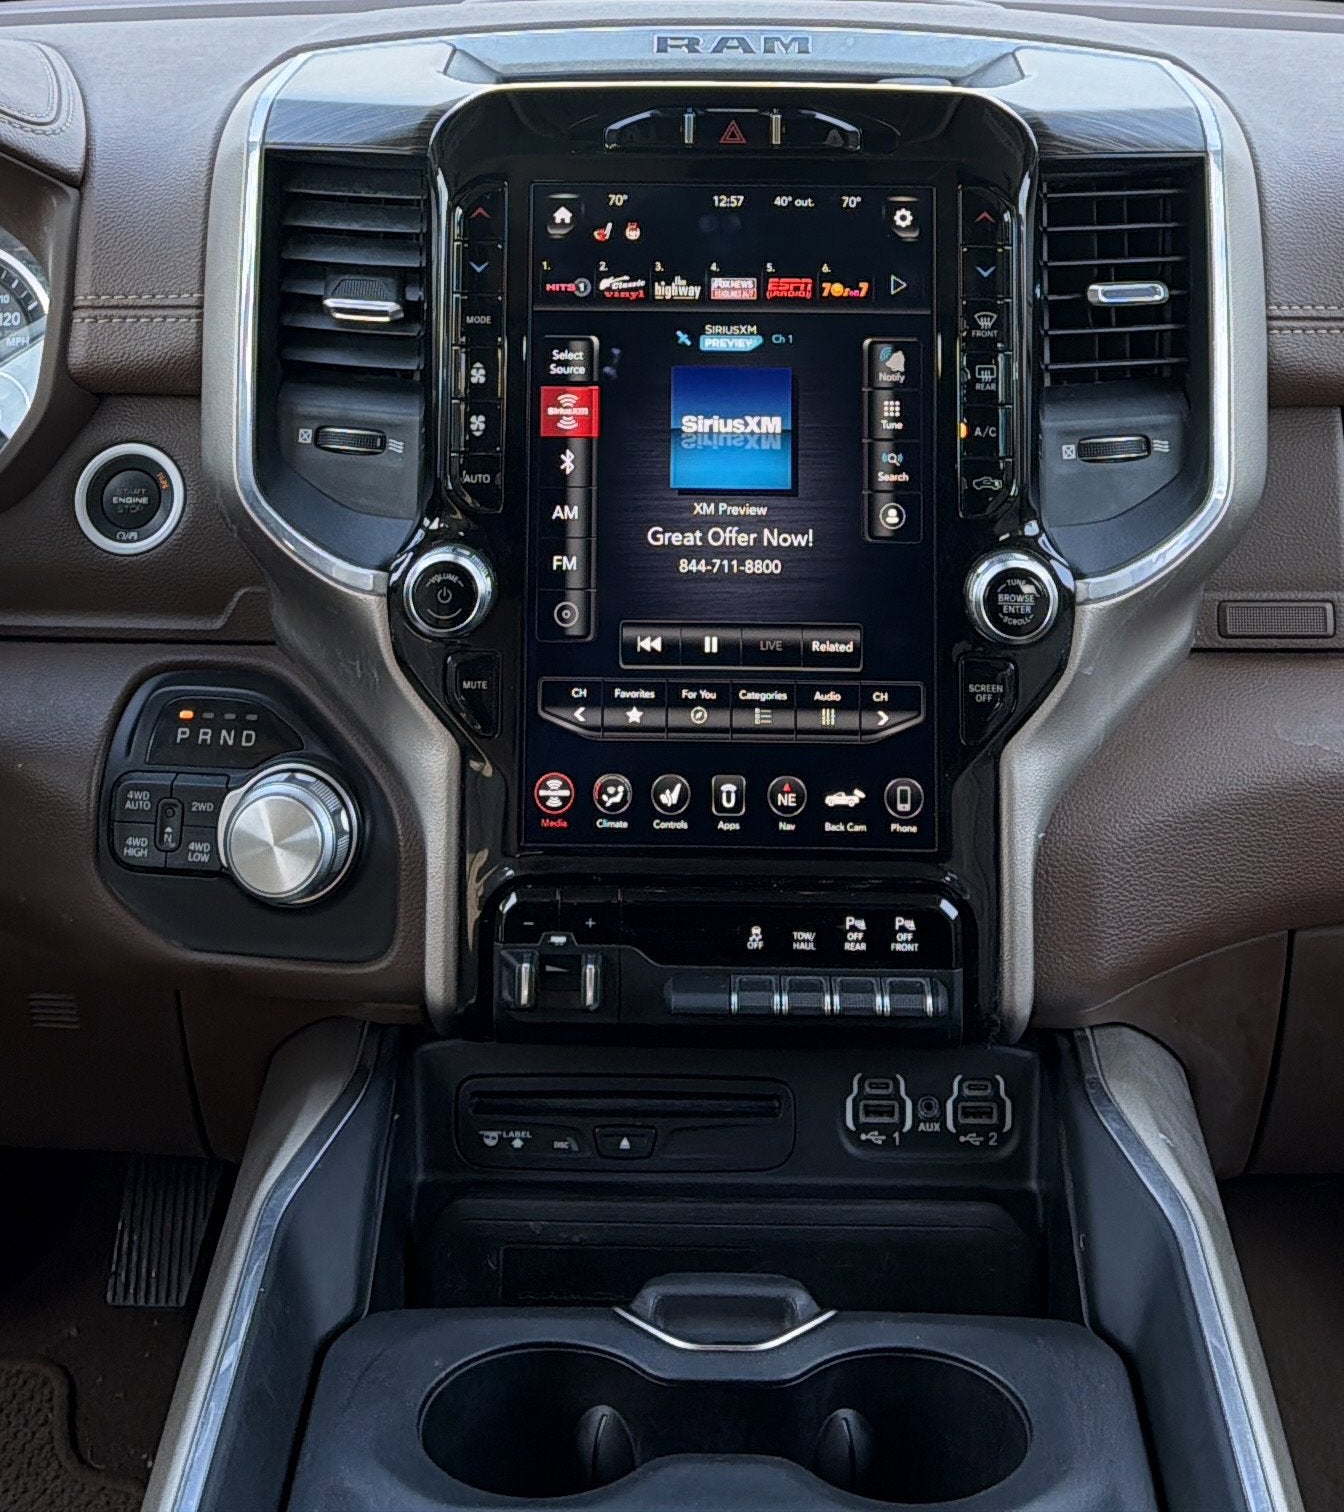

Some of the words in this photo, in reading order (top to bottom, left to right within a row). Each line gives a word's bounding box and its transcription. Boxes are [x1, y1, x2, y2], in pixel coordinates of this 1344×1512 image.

[654, 35, 812, 54] RAM
[608, 194, 628, 206] 70°
[712, 195, 744, 207] 12:57
[773, 195, 792, 207] 40°
[841, 195, 862, 208] 70°
[655, 281, 701, 299] highway
[466, 315, 492, 325] MODE
[705, 324, 757, 334] SIRIUSXM
[971, 329, 998, 338] FRONT
[772, 334, 785, 343] Ch
[552, 349, 584, 360] Select
[549, 363, 586, 375] Source
[878, 372, 905, 384] Notify
[975, 382, 998, 392] REAR
[681, 415, 782, 433] SiriusXM
[880, 419, 903, 430] Tune
[973, 426, 997, 438] A/C
[463, 473, 491, 484] AUTO
[877, 472, 909, 482] Search
[112, 496, 149, 504] ENGINE
[552, 505, 579, 521] AM
[693, 503, 714, 515] XM
[719, 503, 768, 515] Preview
[647, 527, 702, 546] Great
[708, 527, 757, 546] Offer
[763, 528, 813, 547] Now!
[552, 556, 577, 571] FM
[678, 559, 782, 574] 844-711-8800
[429, 572, 459, 584] VOLUME
[998, 594, 1035, 603] BROWSE
[1003, 606, 1032, 614] ENTER
[1002, 615, 1030, 626] SCROLL
[759, 641, 783, 651] LIVE
[812, 641, 854, 653] Related
[462, 681, 488, 689] MUTE
[969, 684, 1003, 692] SCREEN
[571, 688, 587, 698] CH
[614, 688, 656, 699] Favorites
[681, 690, 697, 699] For
[700, 690, 717, 700] You
[739, 690, 788, 702] Categories
[814, 691, 841, 702] Audio
[872, 692, 888, 702] CH
[975, 694, 993, 702] OFF
[176, 728, 190, 744] P
[198, 729, 212, 745] R
[219, 730, 235, 746] N
[241, 731, 256, 747] D
[126, 790, 150, 799] 4WD
[777, 793, 797, 807] NE
[125, 802, 151, 810] AUTO
[191, 802, 214, 812] 2WD
[541, 819, 568, 827] Media
[596, 819, 628, 828] Climate
[653, 820, 688, 829] Controls
[717, 821, 740, 832] Apps
[779, 822, 796, 831] Nav
[824, 822, 845, 832] Back
[846, 822, 867, 832] Cam
[890, 823, 917, 833] Phone
[126, 837, 148, 846] 4WD
[188, 842, 210, 851] 4WD
[123, 848, 148, 857] HIGH
[188, 853, 210, 862] LOW
[792, 931, 816, 941] TOW/
[847, 932, 864, 941] OFF
[896, 932, 913, 942] OFF
[747, 941, 764, 950] OFF
[793, 941, 816, 950] HAUL
[844, 942, 866, 951] REAR
[891, 943, 919, 952] FRONT
[918, 1122, 940, 1132] AUX
[893, 1131, 900, 1145] 1
[989, 1131, 998, 1145] 2
